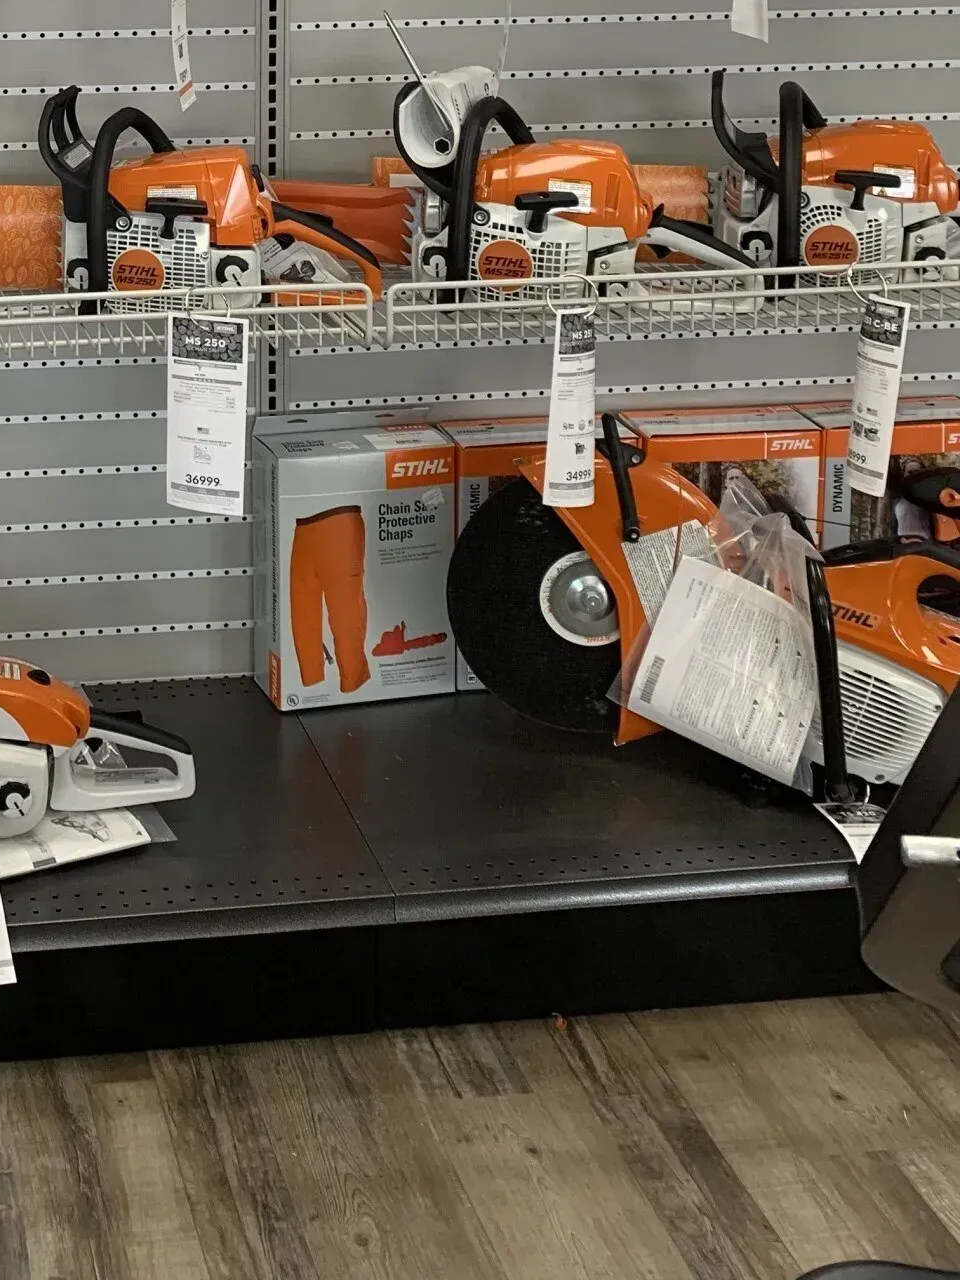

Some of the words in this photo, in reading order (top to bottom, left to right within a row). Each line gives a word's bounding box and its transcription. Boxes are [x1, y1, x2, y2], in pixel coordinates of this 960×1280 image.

[810, 242, 854, 251] STIHL
[483, 255, 527, 269] STIHL
[117, 264, 160, 277] STIHL
[873, 319, 898, 333] C-BE
[185, 336, 201, 346] MS
[204, 337, 226, 348] 250
[572, 331, 583, 340] MS
[771, 439, 813, 451] STIHL
[391, 459, 450, 478] STIHL
[833, 463, 844, 513] DYNAMIC
[378, 503, 410, 517] Chain
[378, 514, 436, 529] Protective
[378, 528, 414, 543] Chaps
